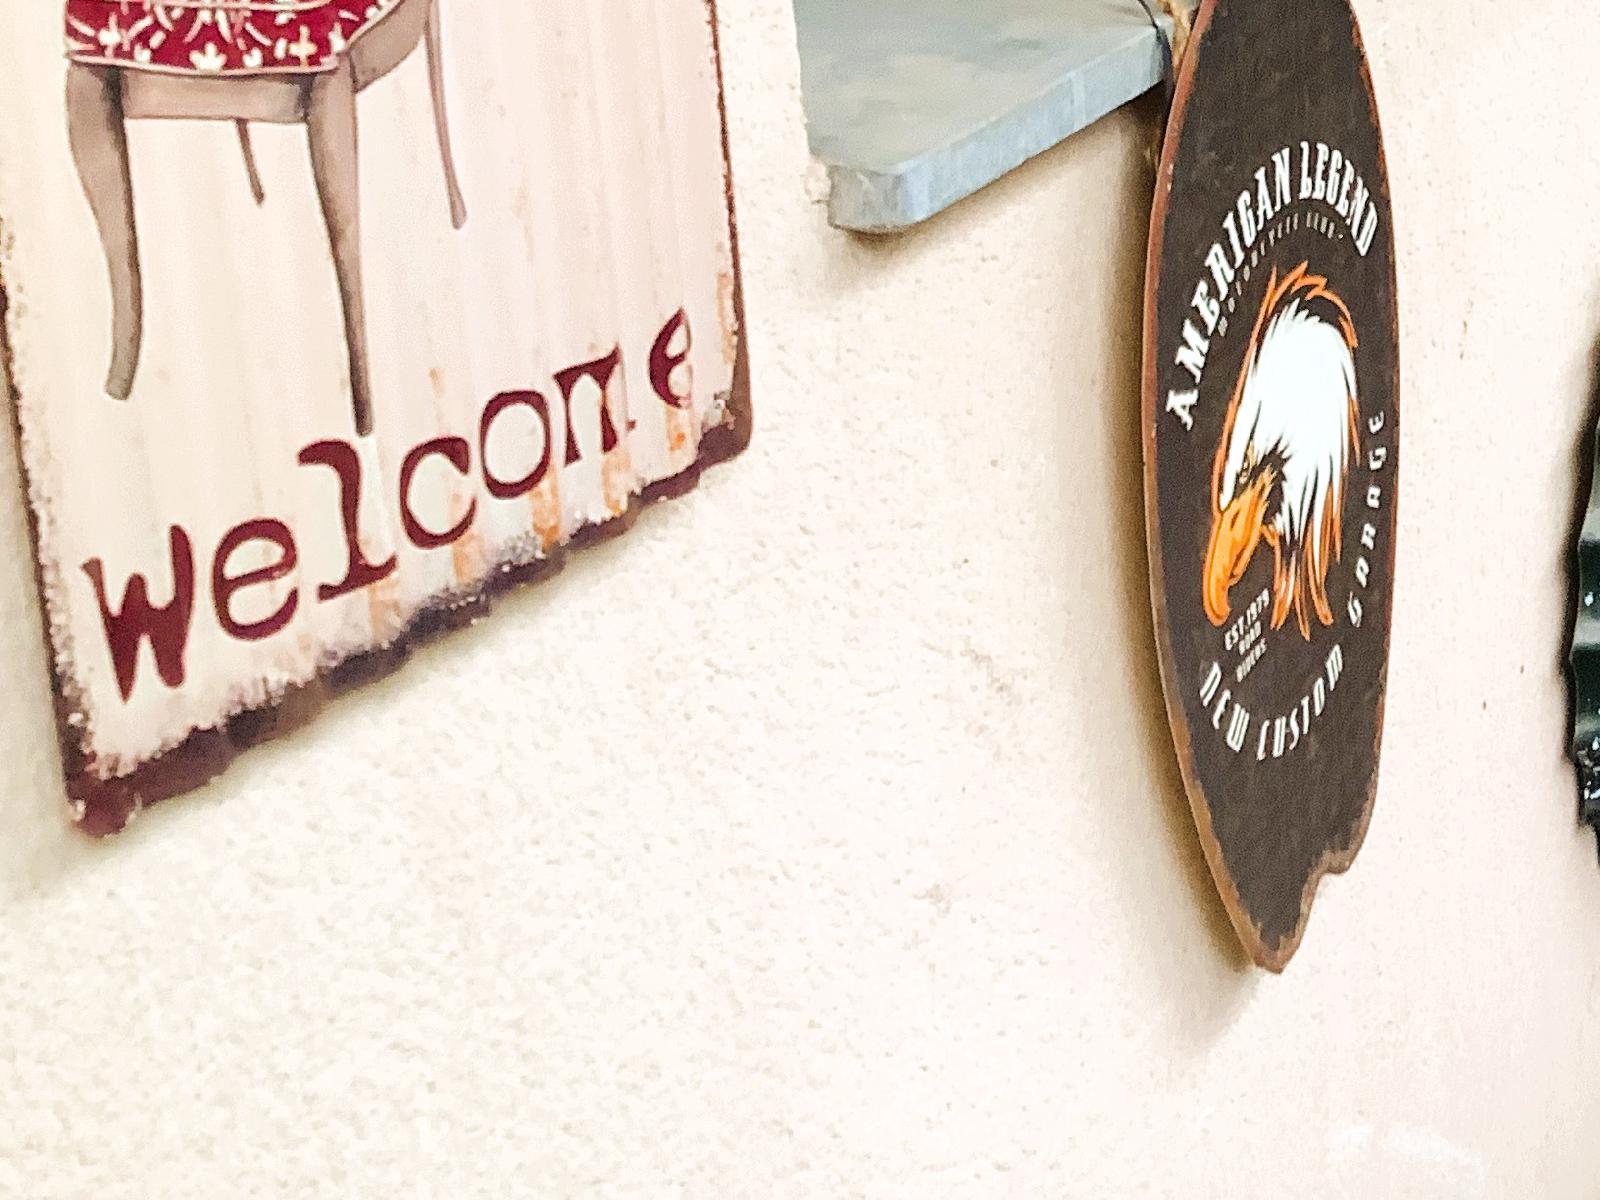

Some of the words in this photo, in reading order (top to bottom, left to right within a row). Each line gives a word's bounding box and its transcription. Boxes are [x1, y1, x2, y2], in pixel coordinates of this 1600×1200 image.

[1165, 146, 1293, 432] AMERICAN
[1298, 139, 1379, 257] LEGEND
[1199, 660, 1250, 752] NEW
[1256, 643, 1344, 762] CUSTOM
[1347, 409, 1387, 629] GARAGE
